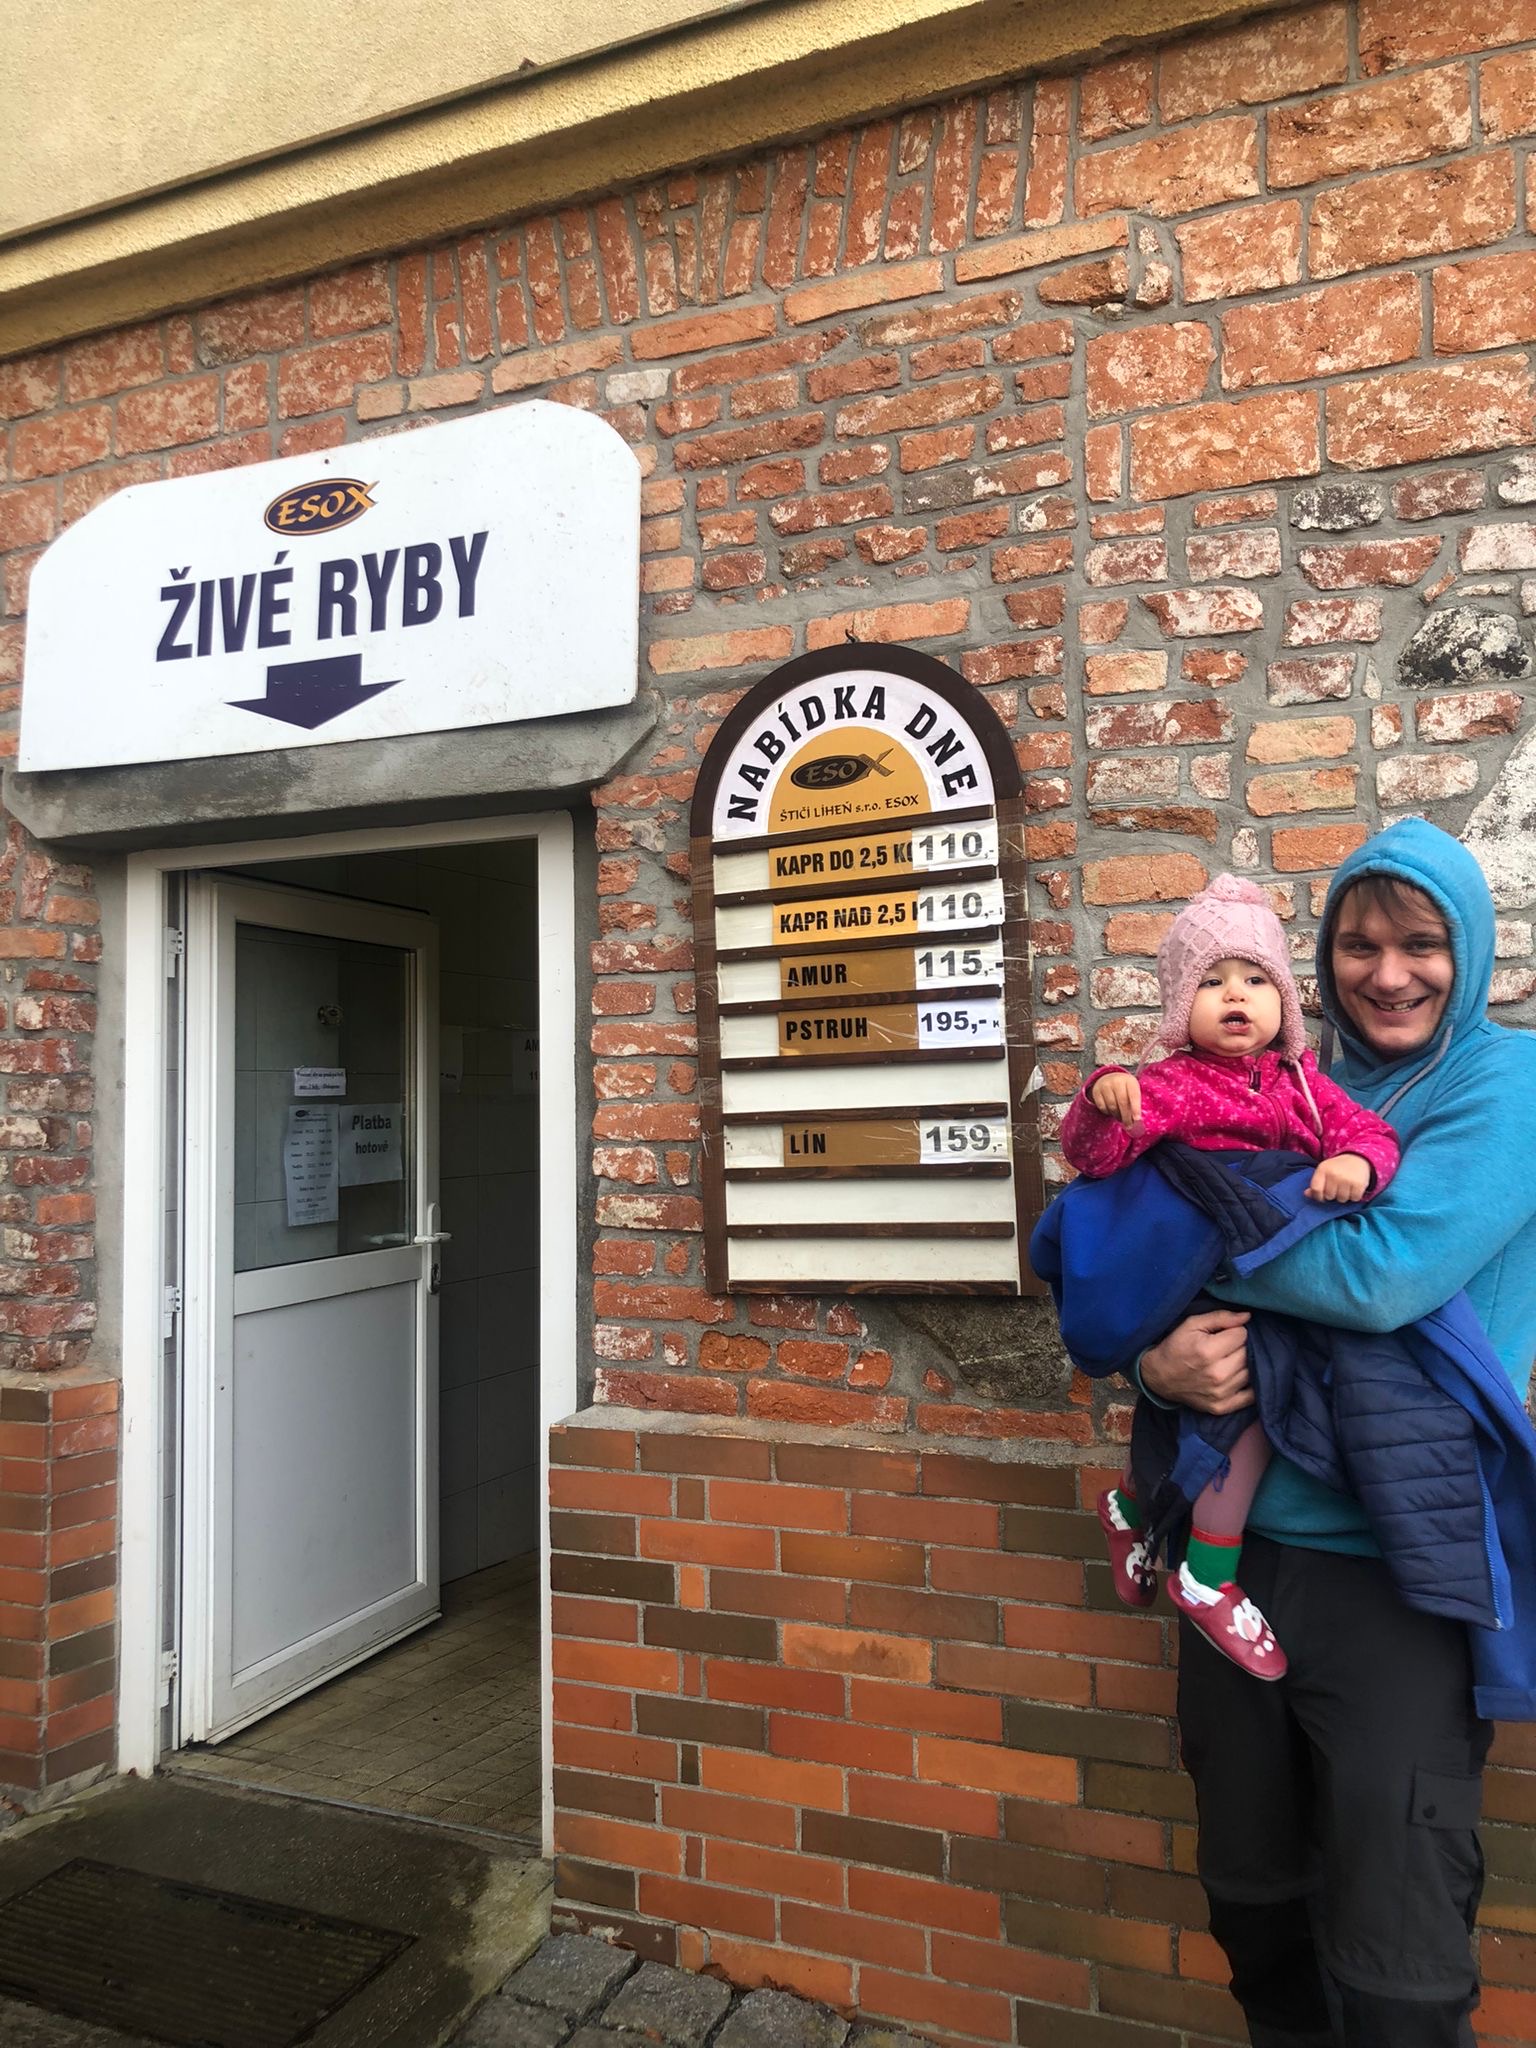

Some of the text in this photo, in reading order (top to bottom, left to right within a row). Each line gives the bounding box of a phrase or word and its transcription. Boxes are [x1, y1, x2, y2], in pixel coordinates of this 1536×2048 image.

[277, 480, 380, 526] ESOX
[156, 531, 489, 662] ŽIVÉ RYBY
[727, 685, 978, 822] NABÍDKA DNE
[804, 748, 895, 784] ESOX
[855, 802, 881, 813] s.r.o.
[885, 794, 919, 809] ESOX
[776, 853, 824, 877] KAPR
[829, 849, 854, 871] DO
[860, 847, 888, 869] 2,5
[780, 910, 828, 934] KAPR
[834, 906, 871, 928] NAD
[877, 903, 906, 926] 2,5
[787, 963, 847, 988] AMUR
[786, 1017, 868, 1041] PSTRUH
[921, 1010, 987, 1034] 195,-
[352, 1114, 392, 1130] Platba
[790, 1129, 826, 1155] LÍN
[926, 1124, 1002, 1153] 159,-
